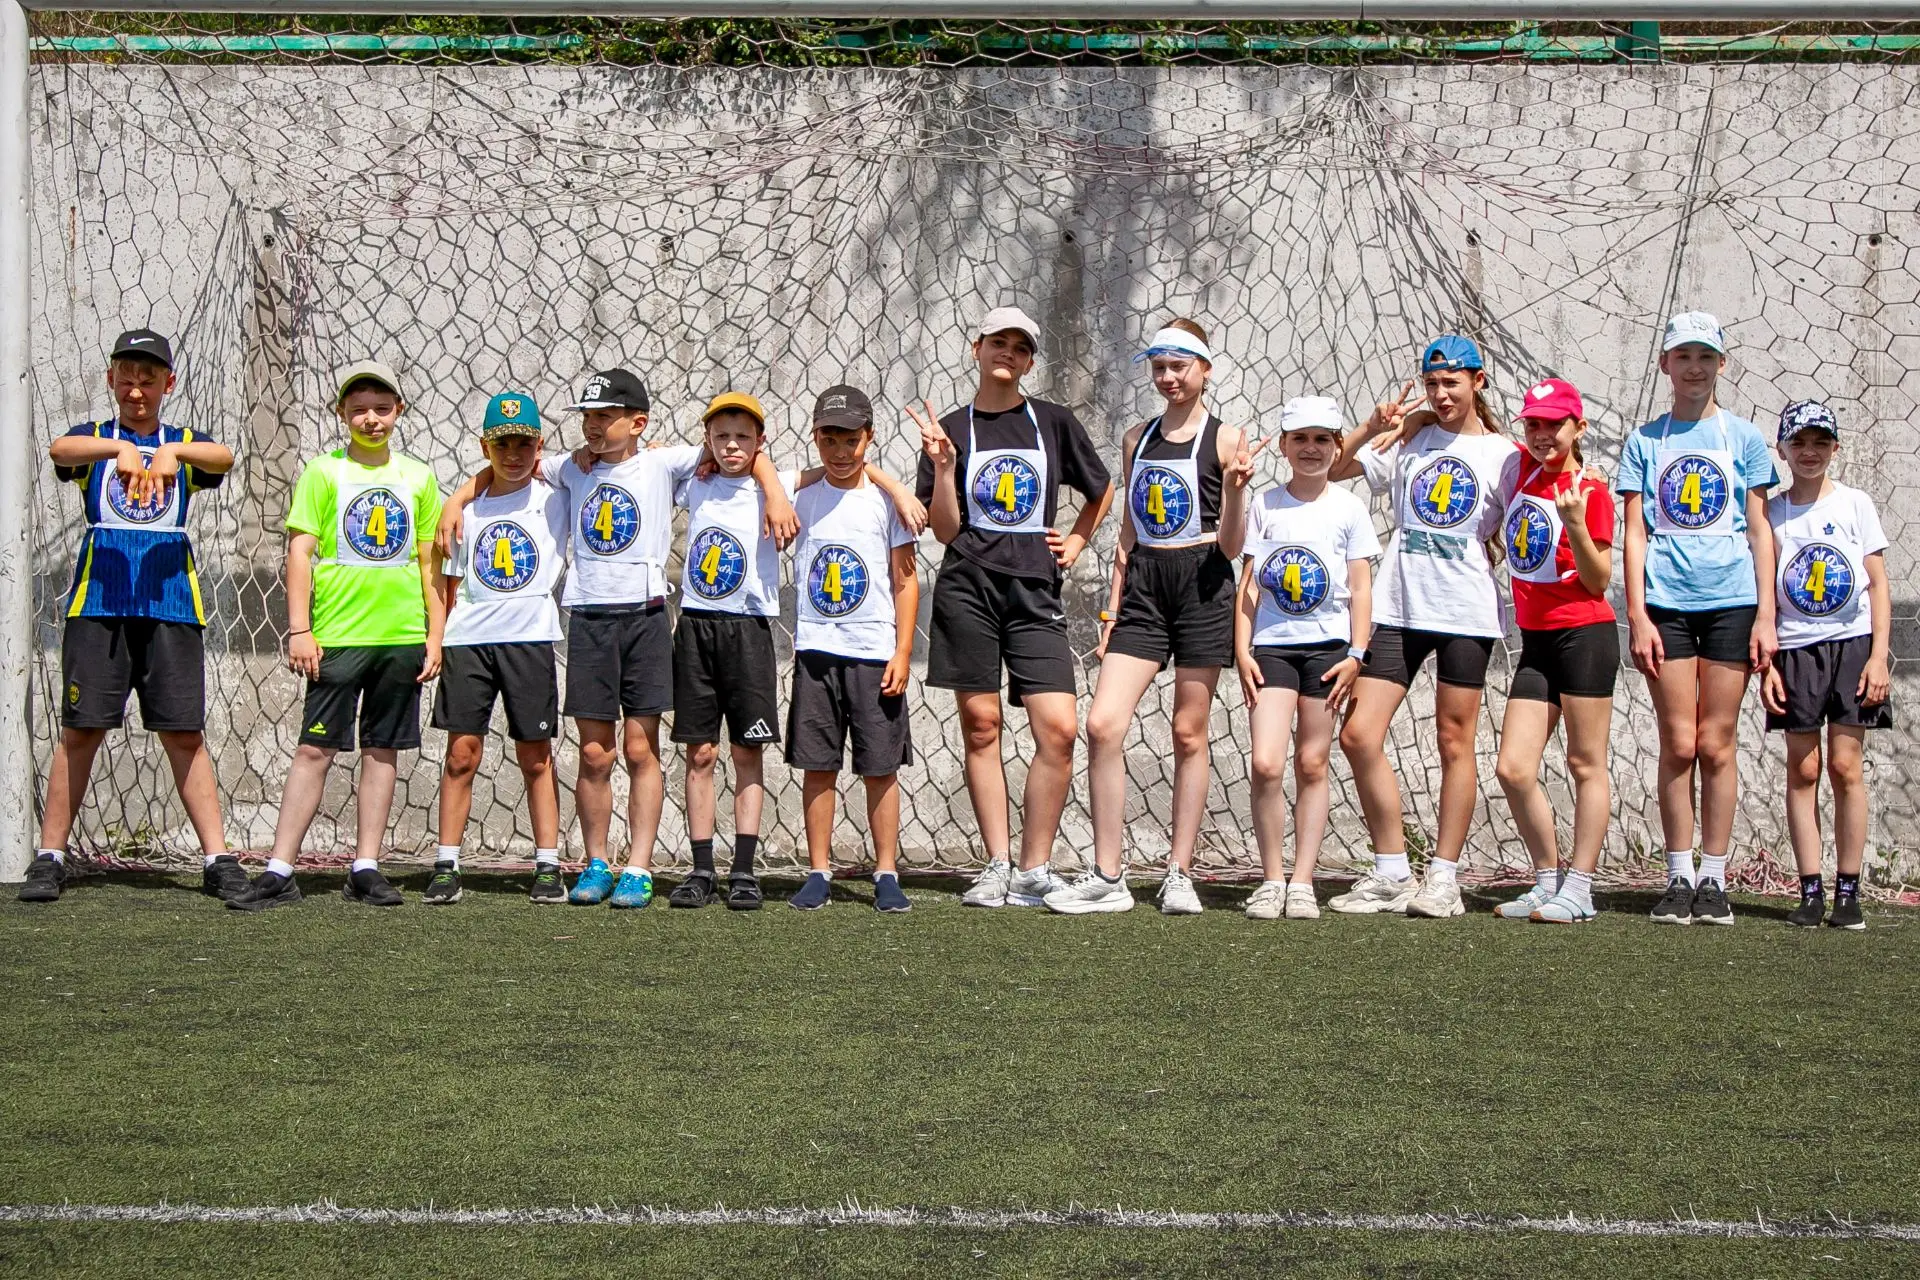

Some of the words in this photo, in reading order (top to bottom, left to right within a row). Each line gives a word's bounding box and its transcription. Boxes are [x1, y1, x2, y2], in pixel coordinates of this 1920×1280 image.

[585, 385, 601, 400] 39
[994, 473, 1016, 512] 4
[1147, 484, 1166, 524] 4
[1429, 474, 1453, 513] 4
[1680, 473, 1703, 513] 4
[366, 506, 387, 545] 4
[595, 501, 614, 540] 4
[1515, 518, 1528, 558] 4
[494, 538, 515, 576] 4
[700, 545, 721, 585] 4
[823, 563, 843, 602] 4
[1283, 564, 1302, 602] 4
[1805, 560, 1826, 601] 4
